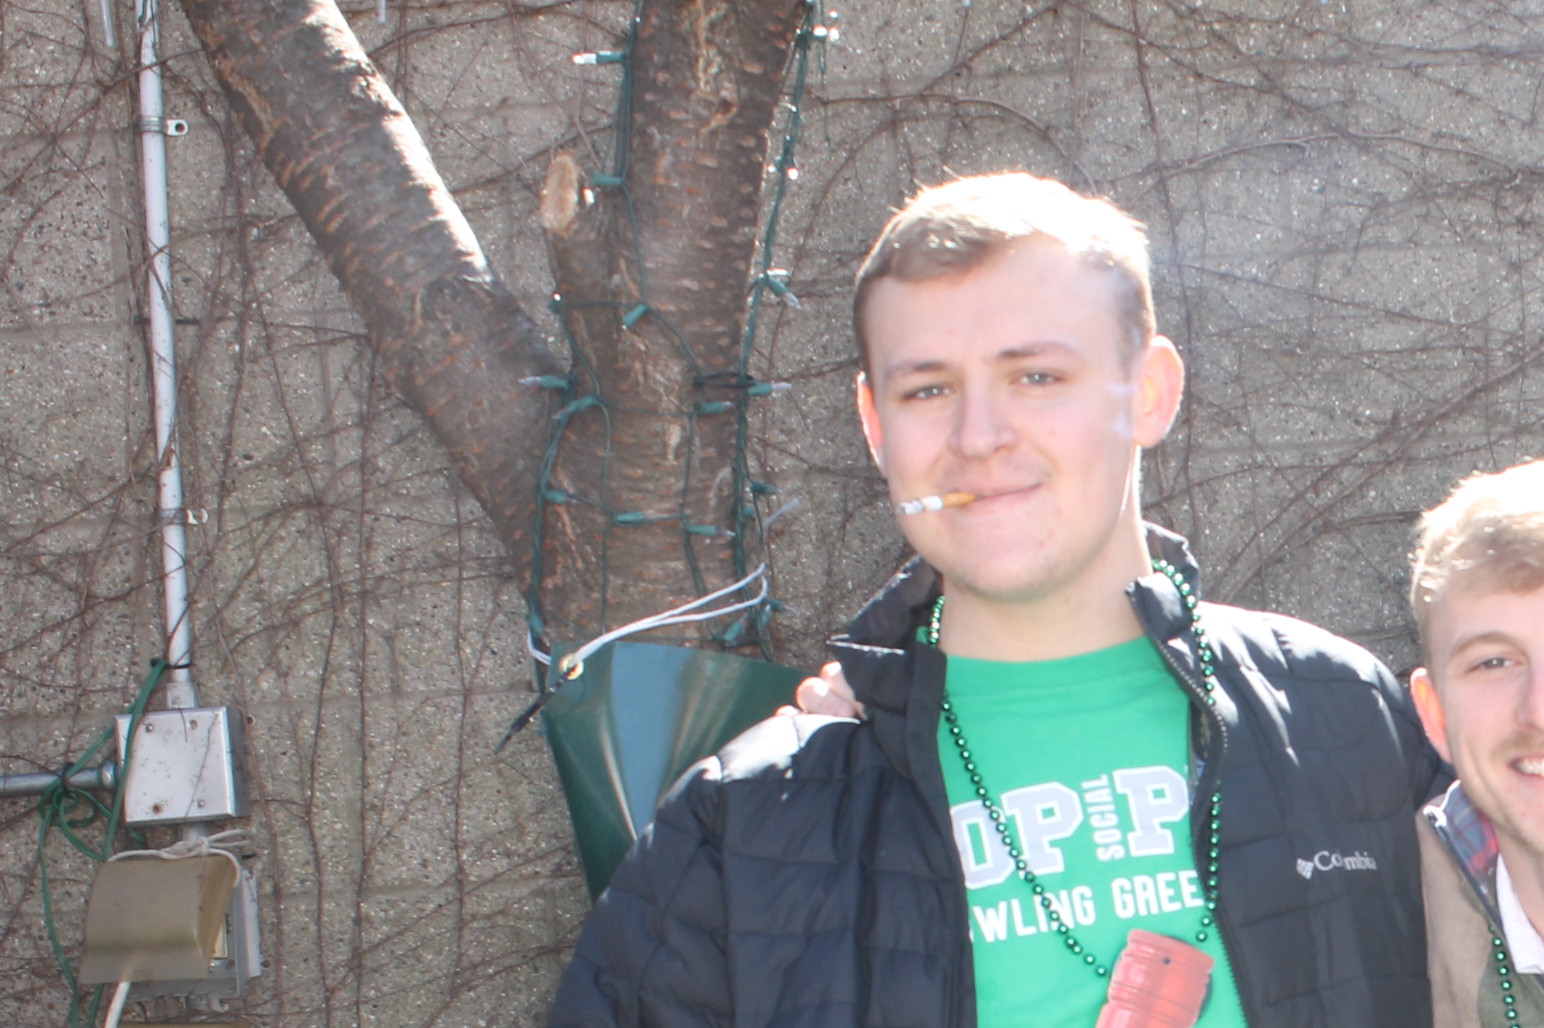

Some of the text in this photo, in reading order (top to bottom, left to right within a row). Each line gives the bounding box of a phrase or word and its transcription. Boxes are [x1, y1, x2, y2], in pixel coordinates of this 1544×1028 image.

[1080, 774, 1125, 861] SOCIAL
[1313, 850, 1378, 871] Combia
[970, 886, 1096, 942] WLING
